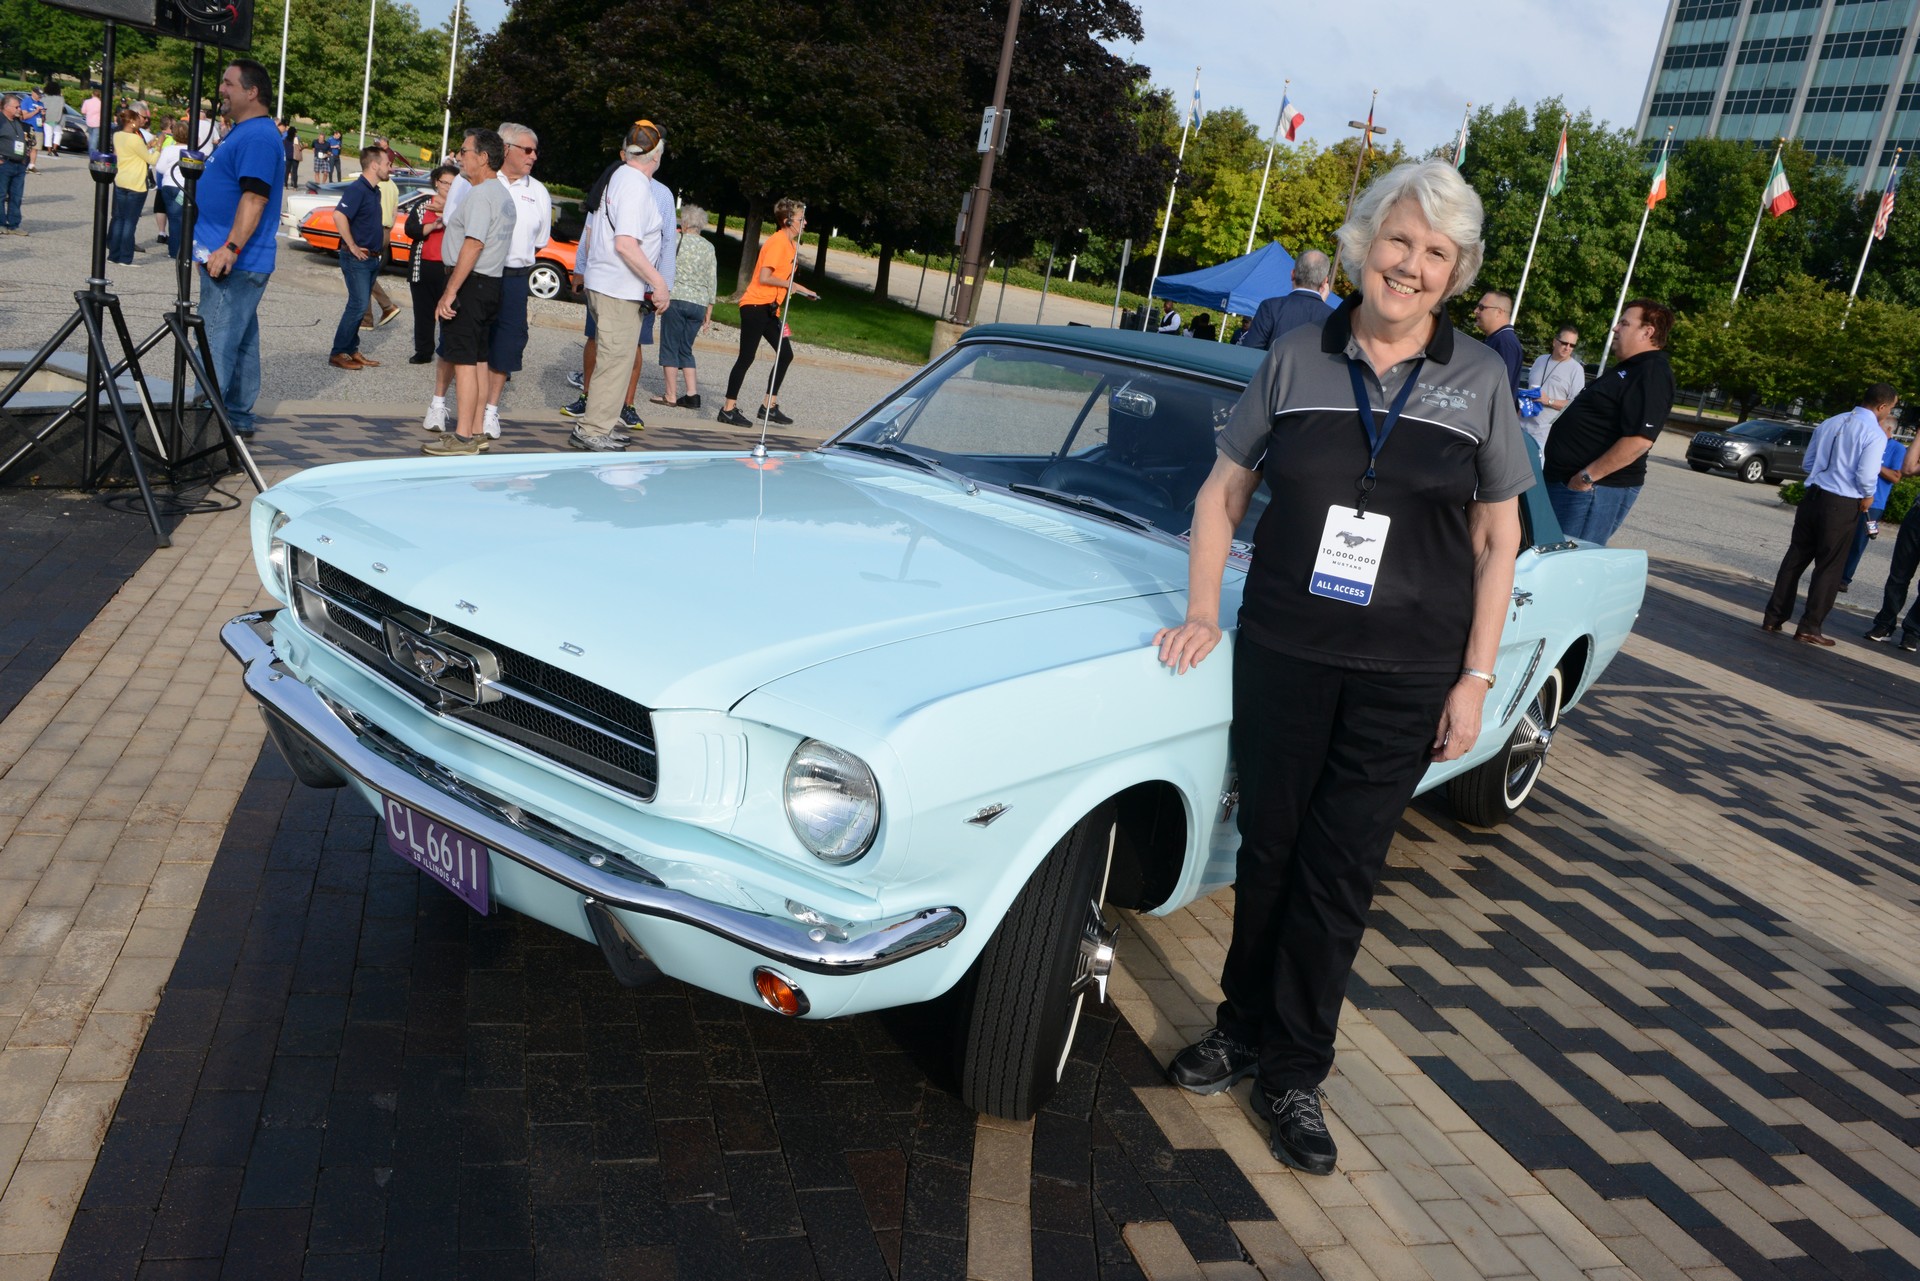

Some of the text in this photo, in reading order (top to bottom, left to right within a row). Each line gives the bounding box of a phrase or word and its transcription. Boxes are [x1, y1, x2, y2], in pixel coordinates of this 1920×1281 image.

[984, 115, 993, 123] LOT
[984, 128, 989, 144] 1
[1322, 548, 1377, 565] 10,000,000
[1332, 560, 1362, 571] MUSTANG
[1316, 580, 1365, 598] ALL ACCESS
[413, 851, 460, 890] 19 ILLINOIS 64
